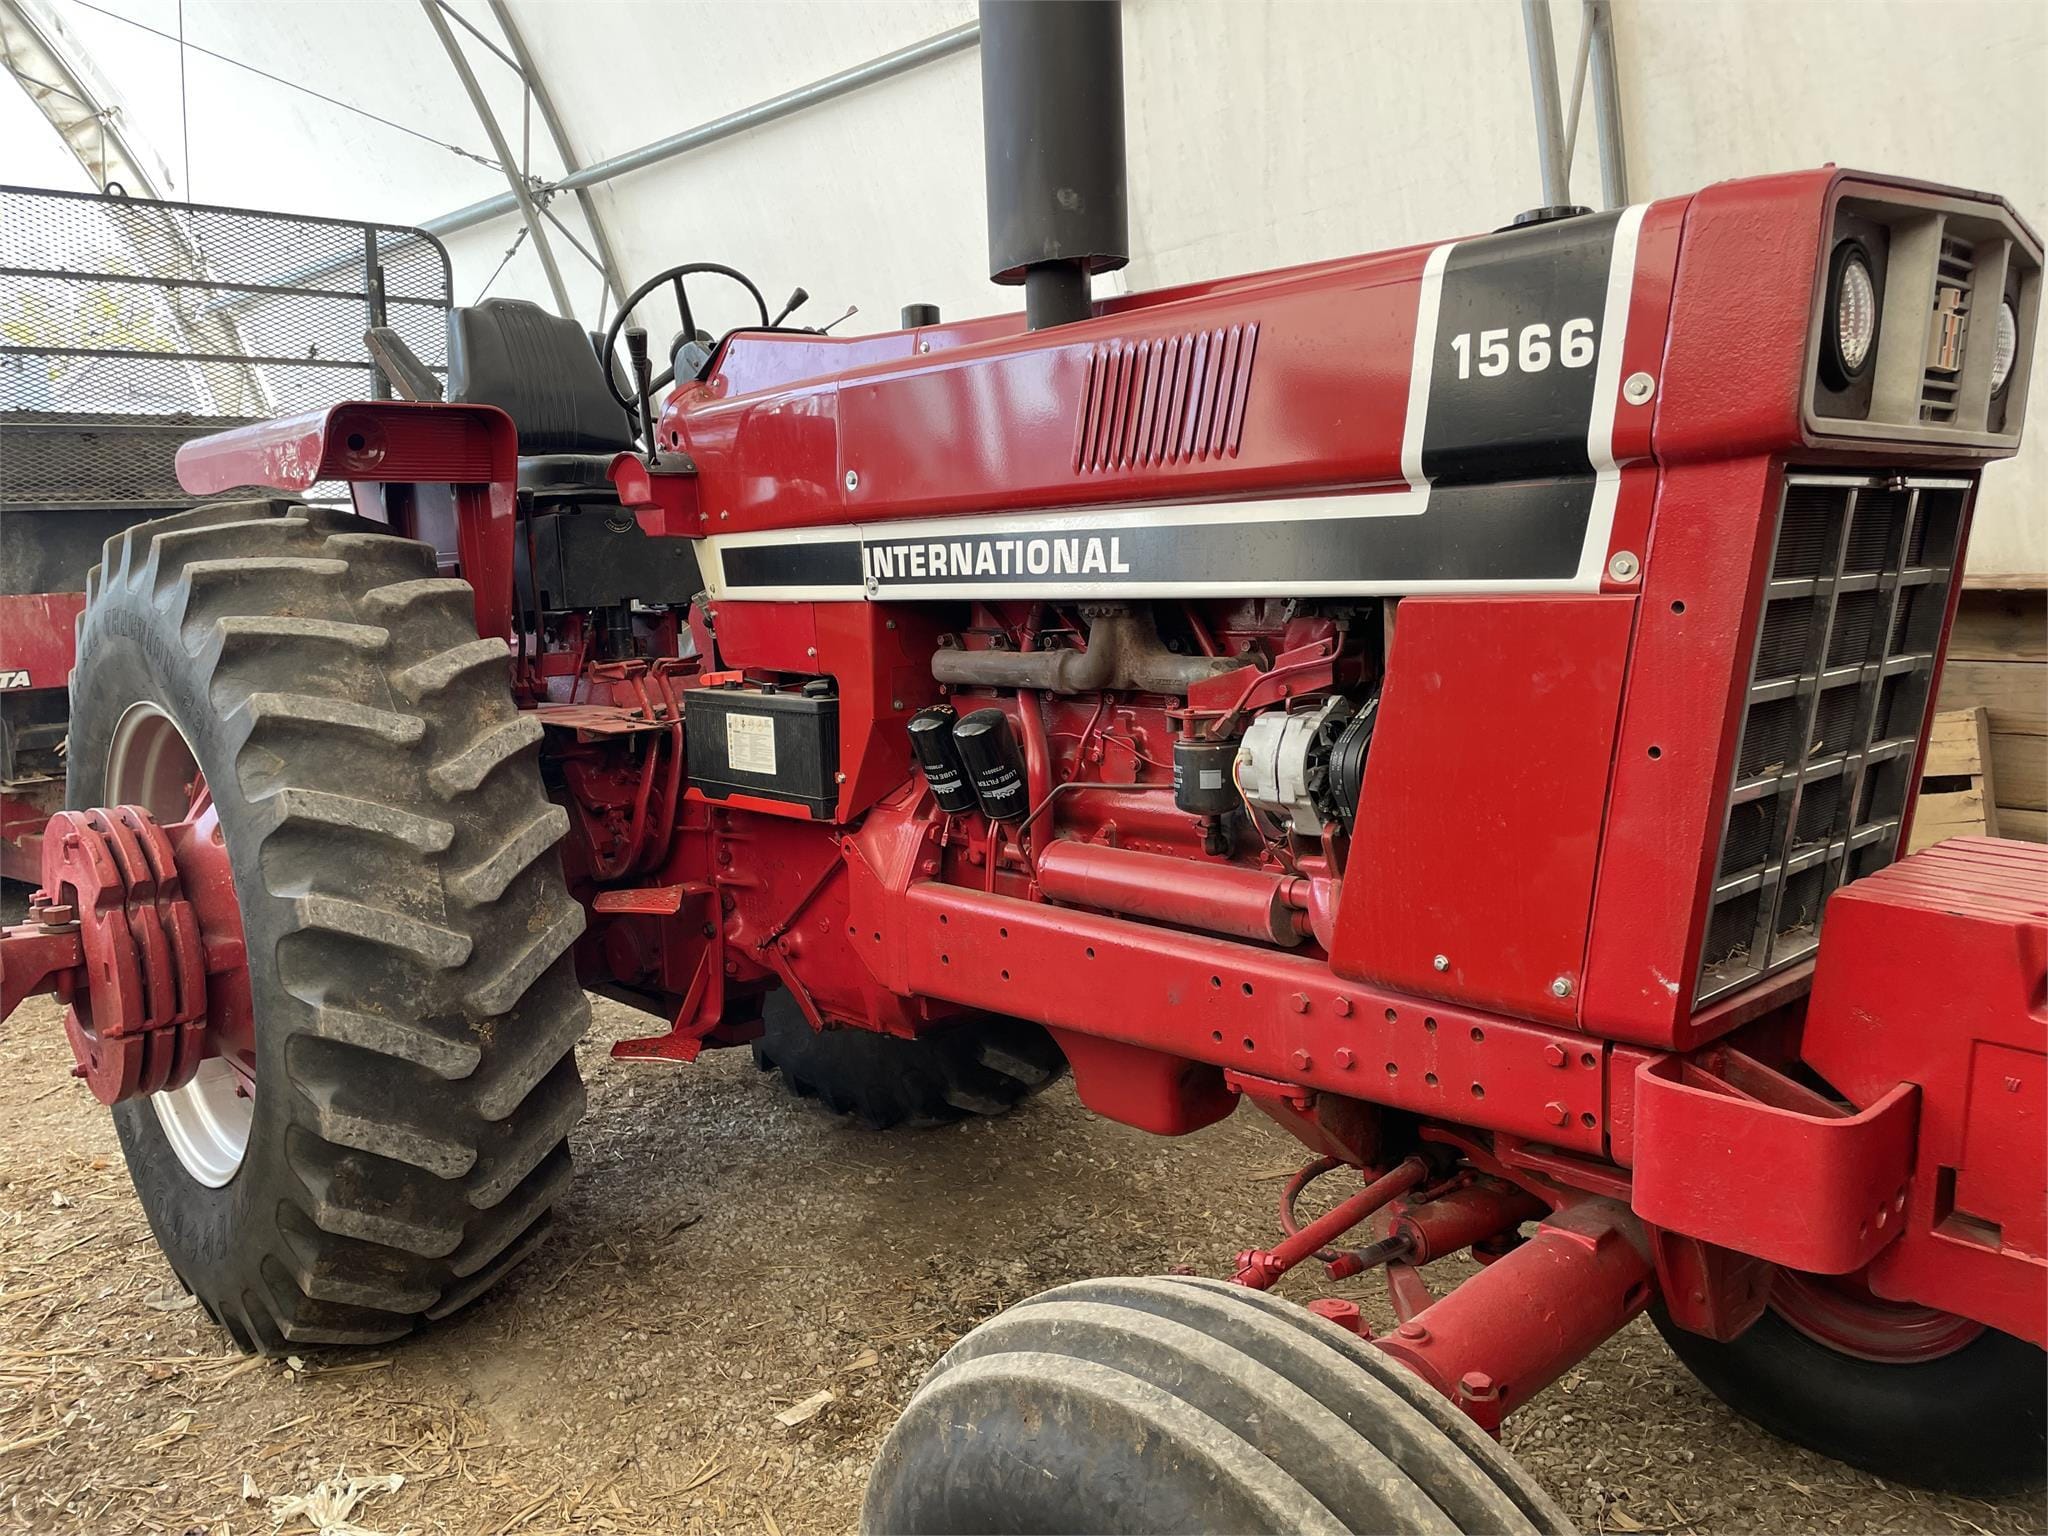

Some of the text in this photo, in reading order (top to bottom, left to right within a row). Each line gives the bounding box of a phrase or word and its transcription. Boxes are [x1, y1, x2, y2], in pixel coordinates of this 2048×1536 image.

[1450, 318, 1595, 380] 1566
[864, 537, 1130, 578] INTERNATIONAL
[977, 769, 1017, 787] LUBE FILTER
